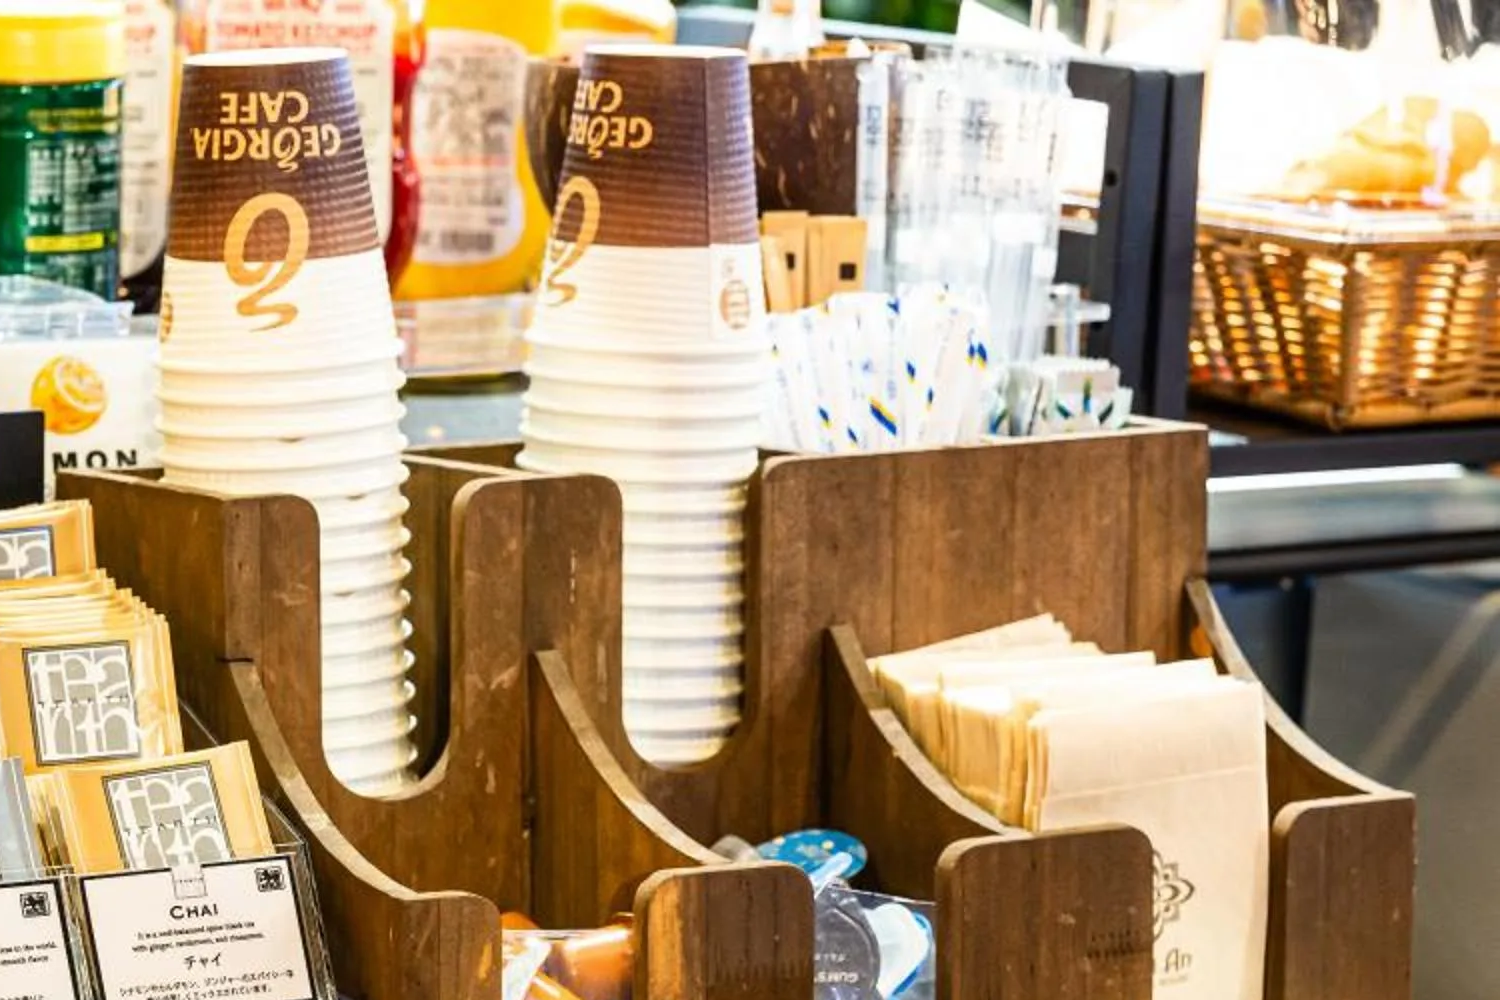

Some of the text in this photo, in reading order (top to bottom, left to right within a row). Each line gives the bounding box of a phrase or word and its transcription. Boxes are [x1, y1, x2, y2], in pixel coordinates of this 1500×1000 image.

[220, 90, 309, 124] CAFE
[192, 124, 341, 172] GEORGIA
[52, 450, 139, 471] MON
[168, 901, 219, 920] CHAI
[182, 952, 223, 970] チャイ
